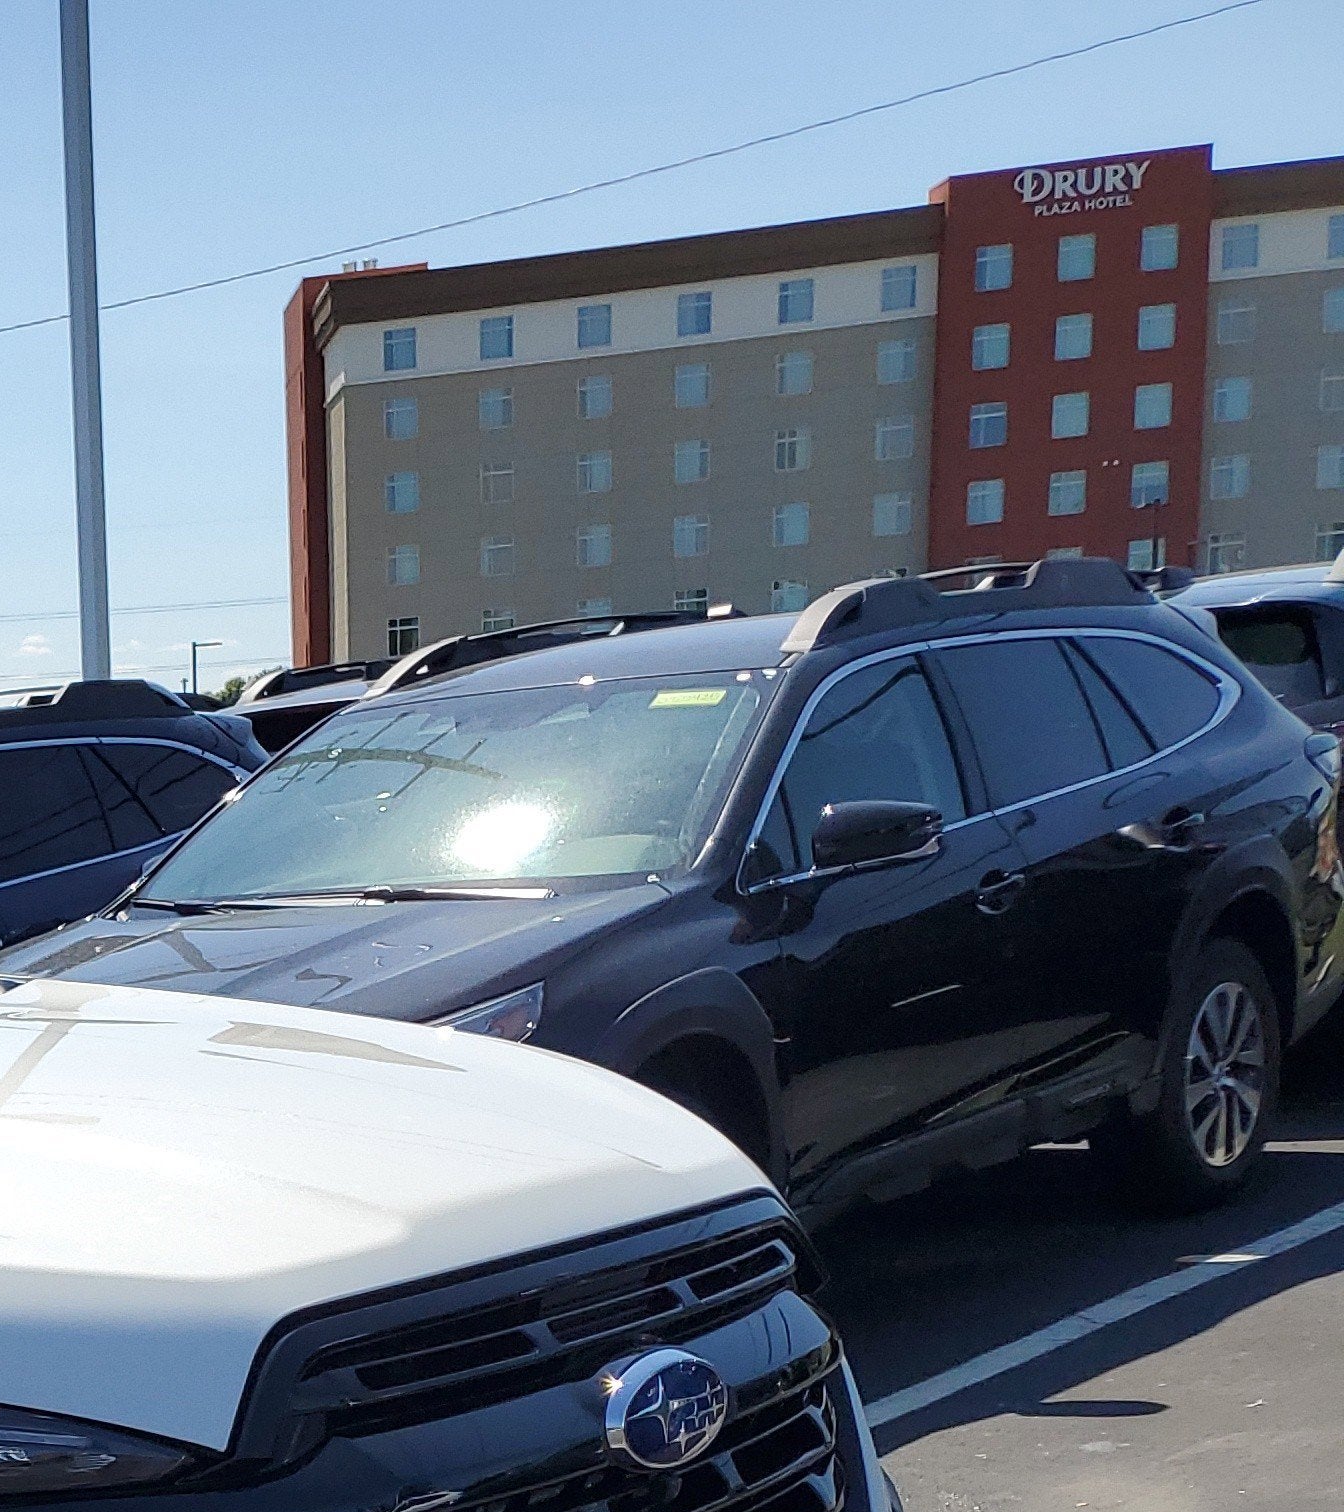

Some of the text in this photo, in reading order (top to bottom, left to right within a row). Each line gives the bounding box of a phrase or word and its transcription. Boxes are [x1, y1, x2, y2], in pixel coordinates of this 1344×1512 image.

[1013, 159, 1151, 203] DRURY
[1034, 193, 1133, 217] PLAZA HOTEL
